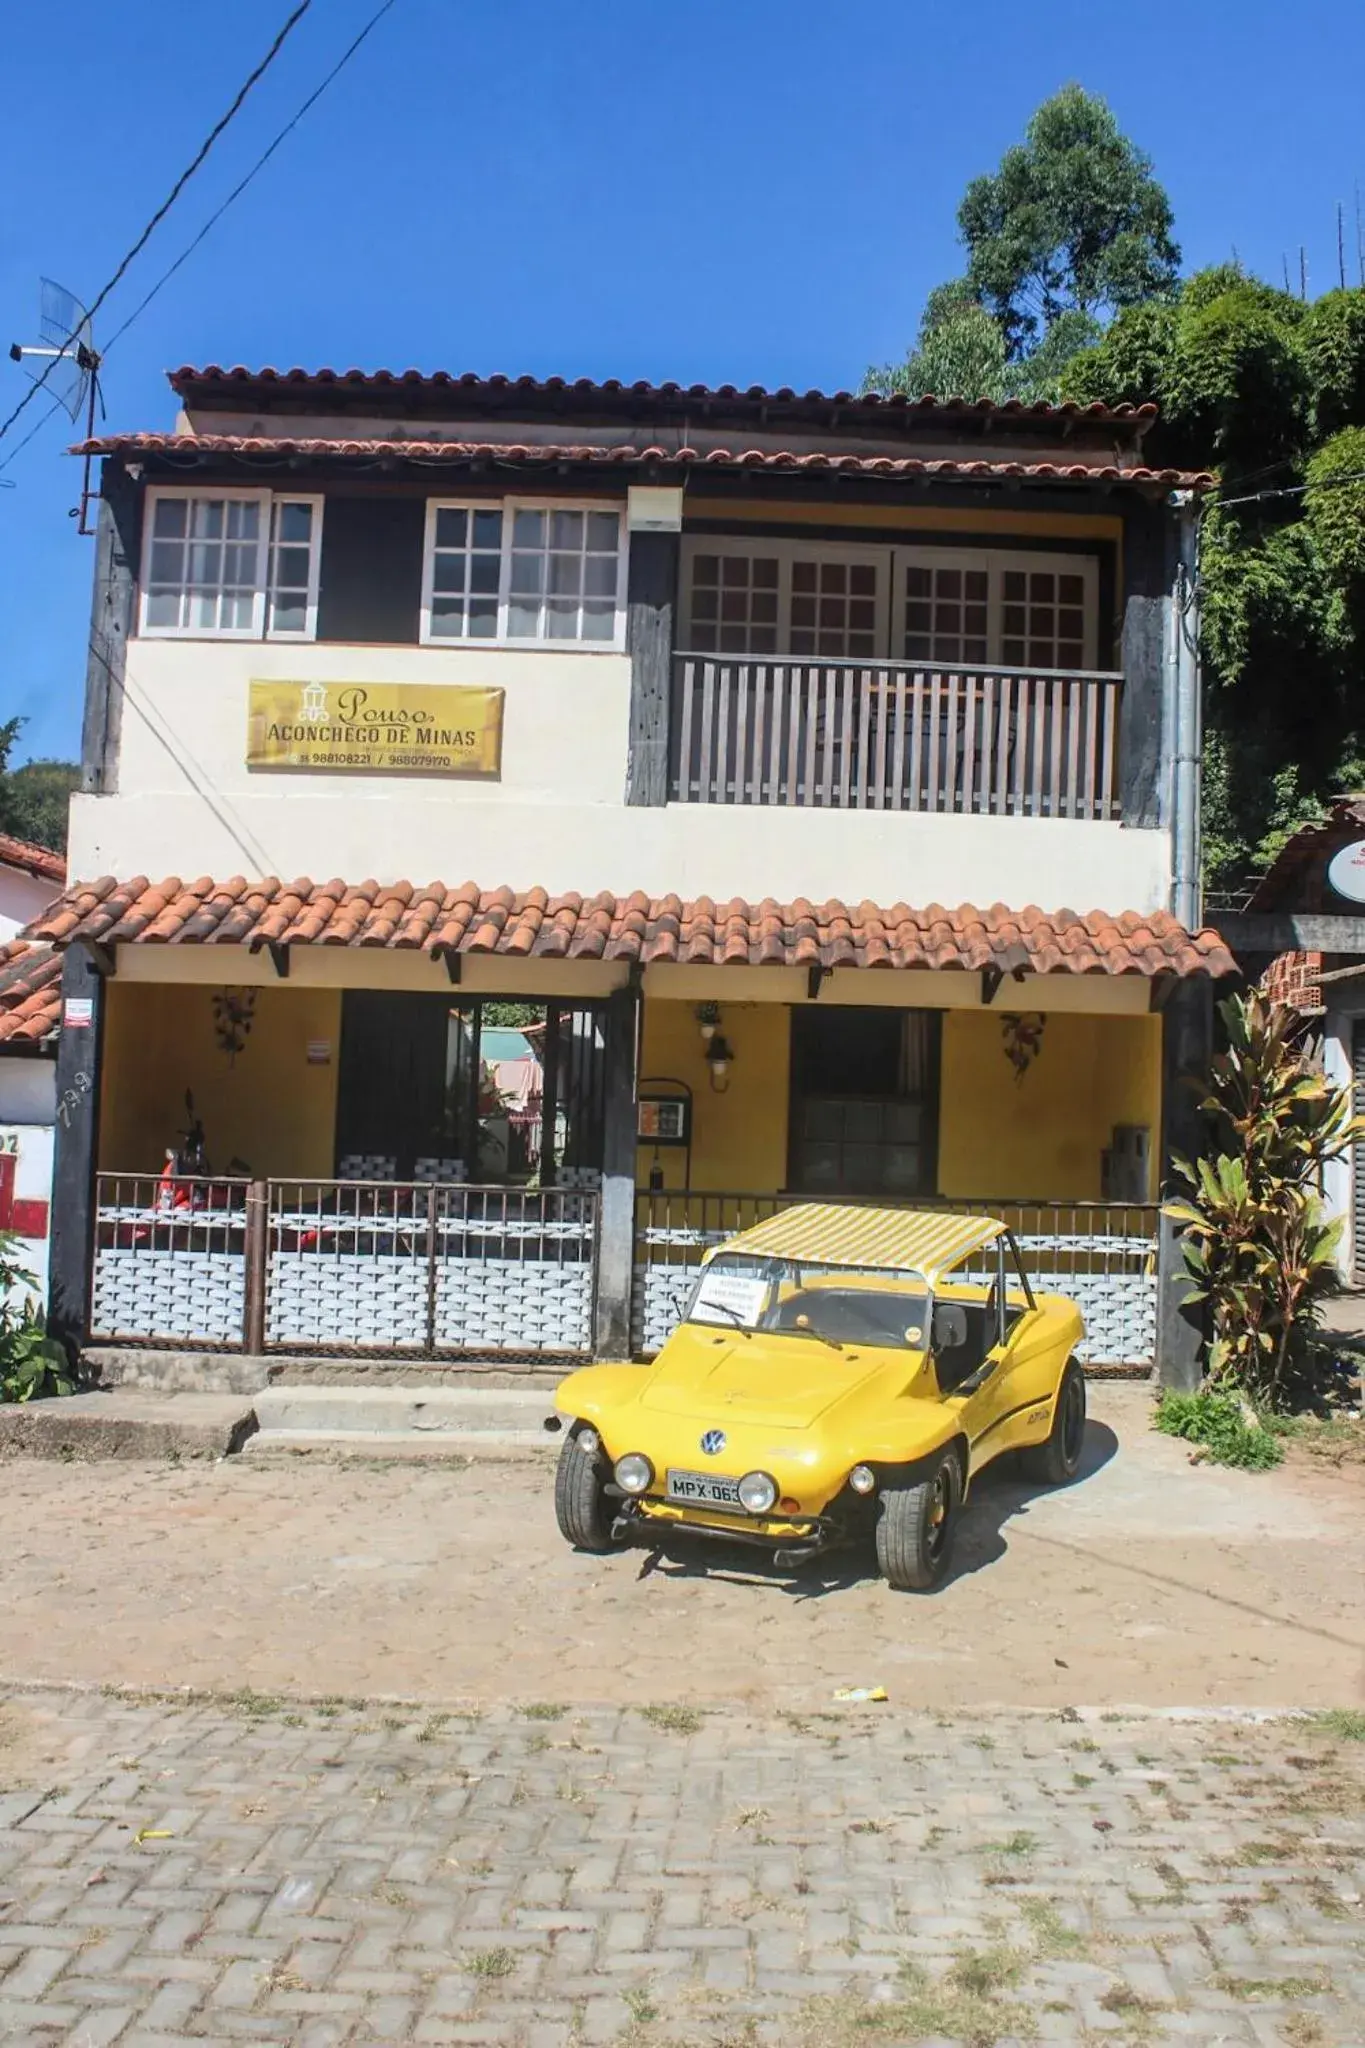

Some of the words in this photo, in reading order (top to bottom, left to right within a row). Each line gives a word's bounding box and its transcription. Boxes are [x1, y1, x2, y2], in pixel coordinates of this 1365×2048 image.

[267, 723, 379, 743] ACONCHEGO
[387, 728, 409, 743] DE
[416, 728, 476, 746] MINAS
